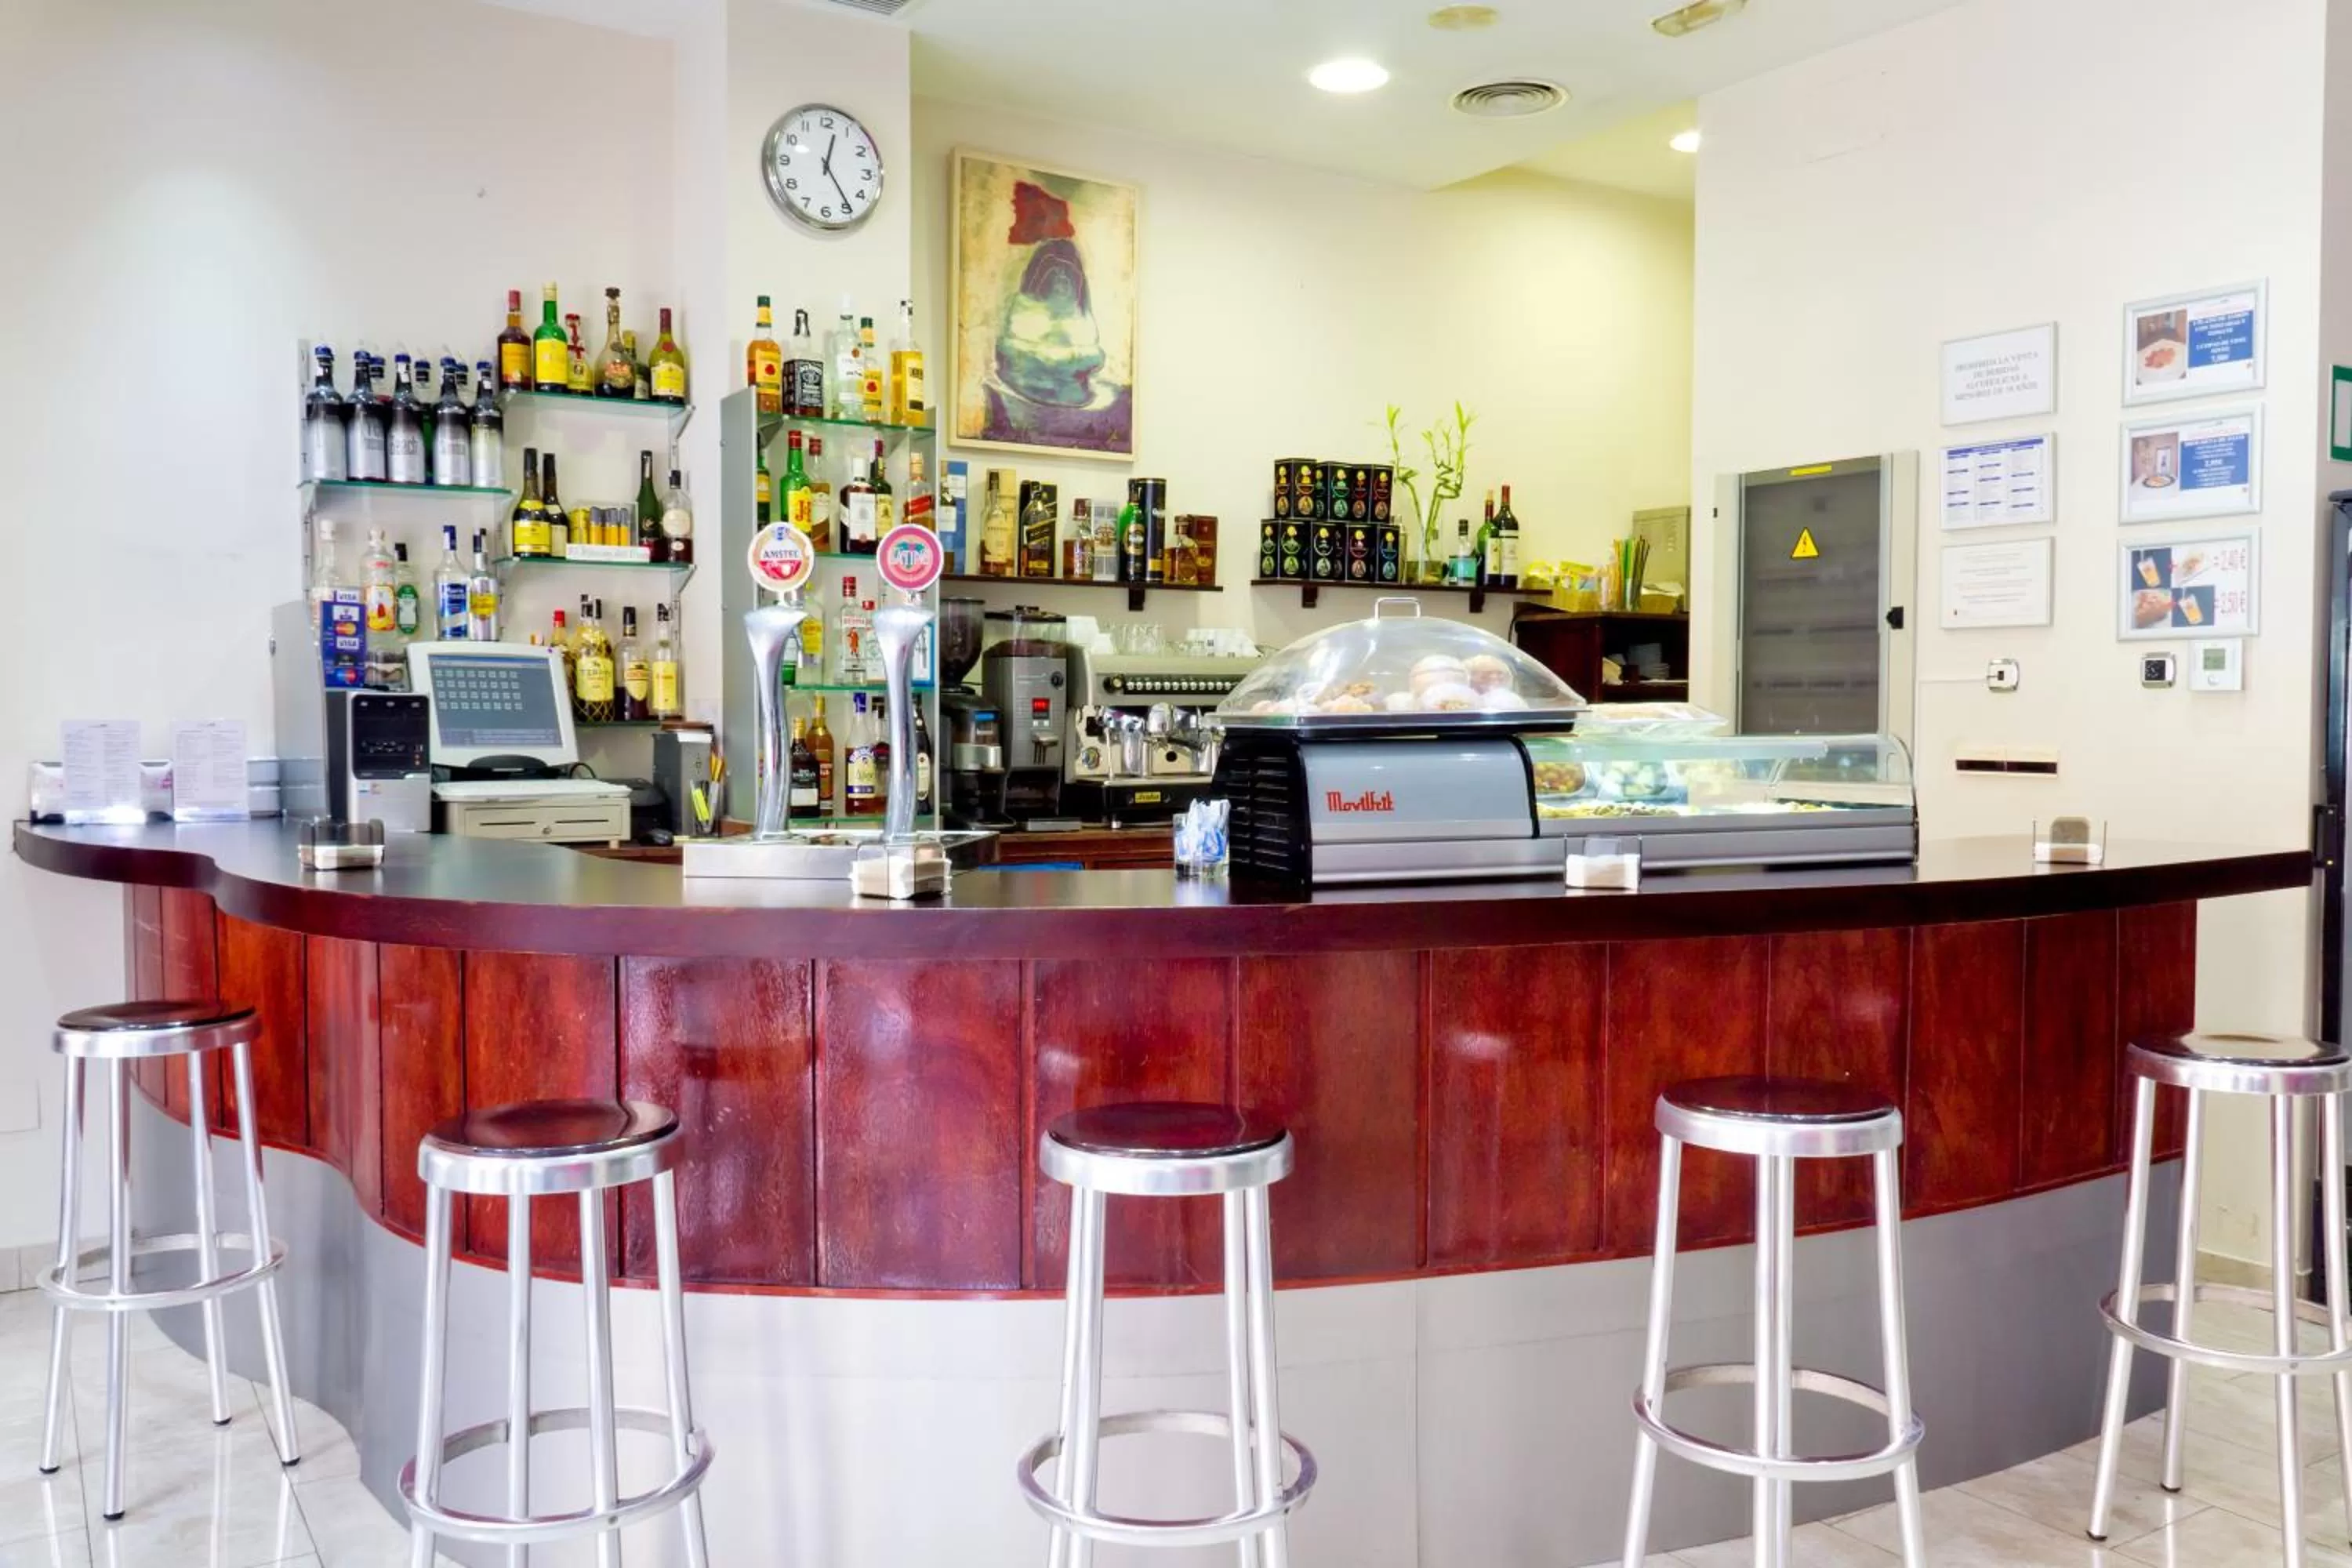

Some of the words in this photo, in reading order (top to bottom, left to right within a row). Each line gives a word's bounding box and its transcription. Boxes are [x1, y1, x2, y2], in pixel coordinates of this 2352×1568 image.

[800, 120, 810, 132] 11
[820, 117, 833, 129] 12
[786, 134, 797, 146] 10
[855, 145, 866, 158] 2
[779, 154, 790, 165] 9
[861, 169, 873, 181] 3
[786, 178, 797, 190] 8
[855, 189, 866, 200] 4
[800, 197, 811, 209] 7
[840, 203, 851, 215] 5
[821, 206, 832, 218] 6
